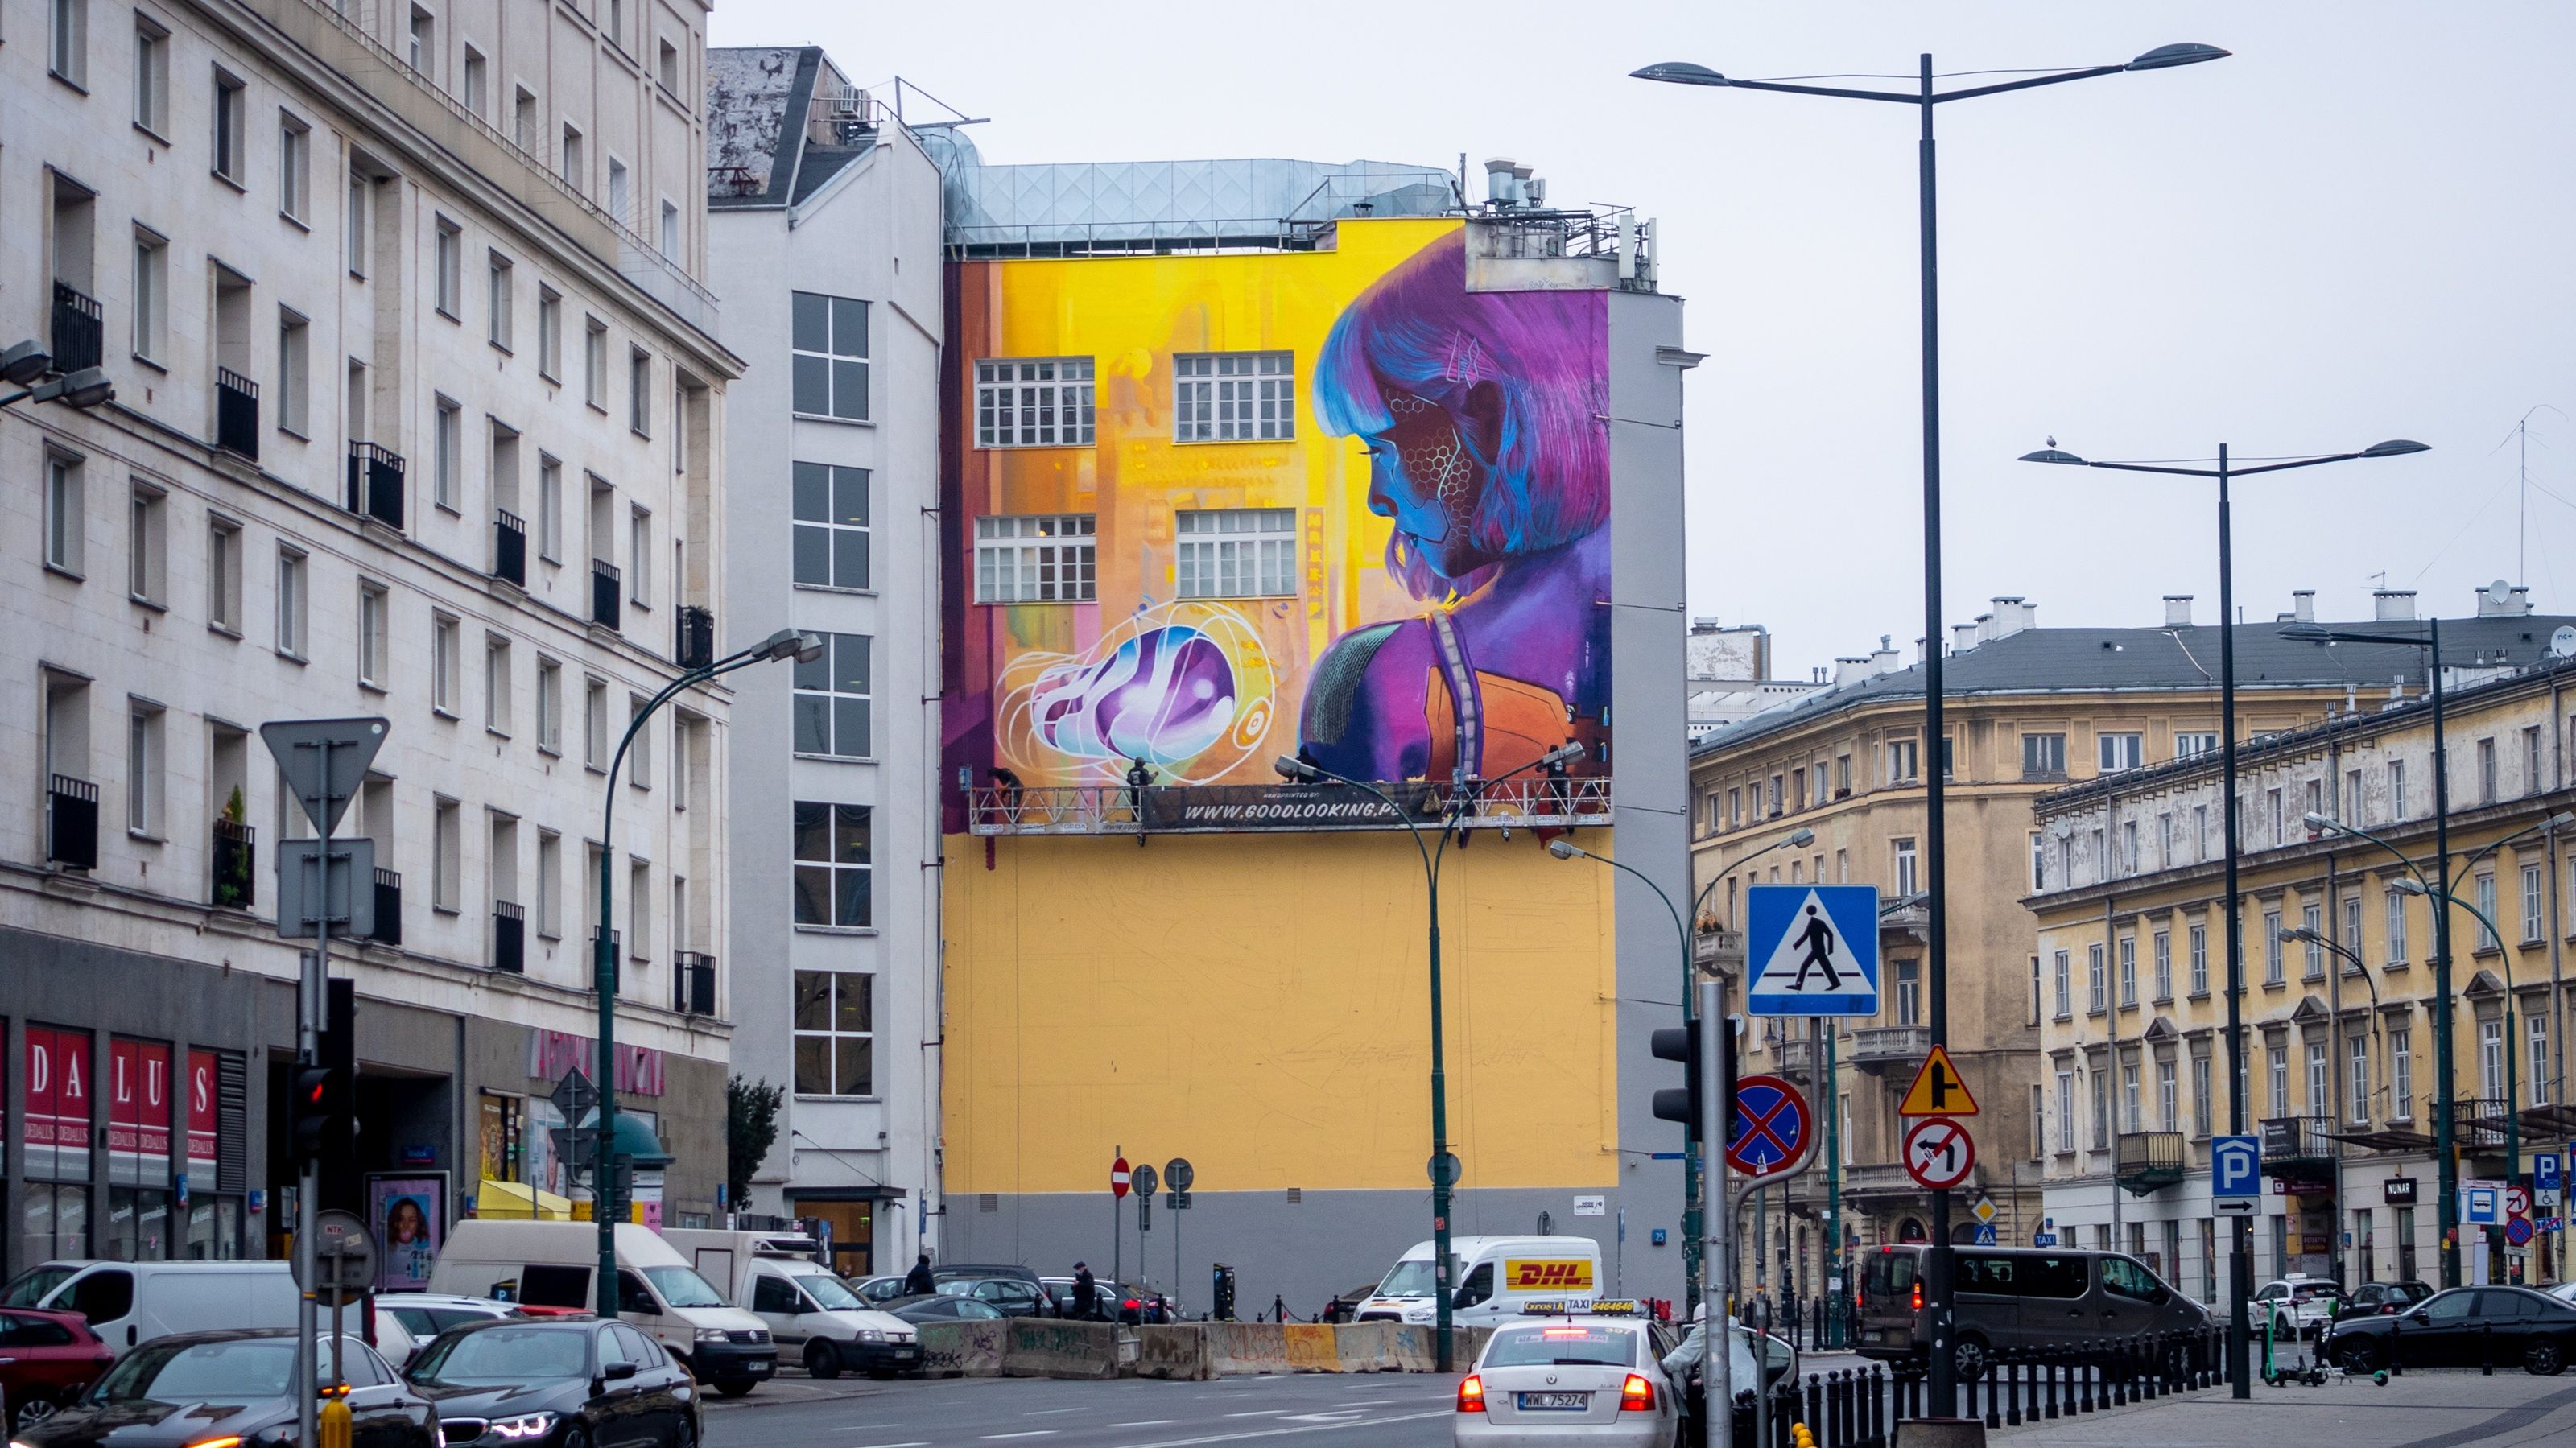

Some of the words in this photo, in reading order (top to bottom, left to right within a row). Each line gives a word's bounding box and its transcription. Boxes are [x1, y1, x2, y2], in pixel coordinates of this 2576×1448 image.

[1184, 802, 1399, 819] WWW.GOODLOOKING.PL
[2223, 1152, 2250, 1189] P
[2540, 1157, 2556, 1179] P
[1655, 1232, 1664, 1242] 25
[2037, 1236, 2055, 1244] TAXI
[1518, 1264, 1582, 1285] DHL
[498, 1290, 506, 1302] P
[1569, 1299, 1590, 1310] TAXI
[1591, 1302, 1633, 1311] 6464646
[1525, 1392, 1546, 1406] WWL
[1551, 1392, 1586, 1407] 75274
